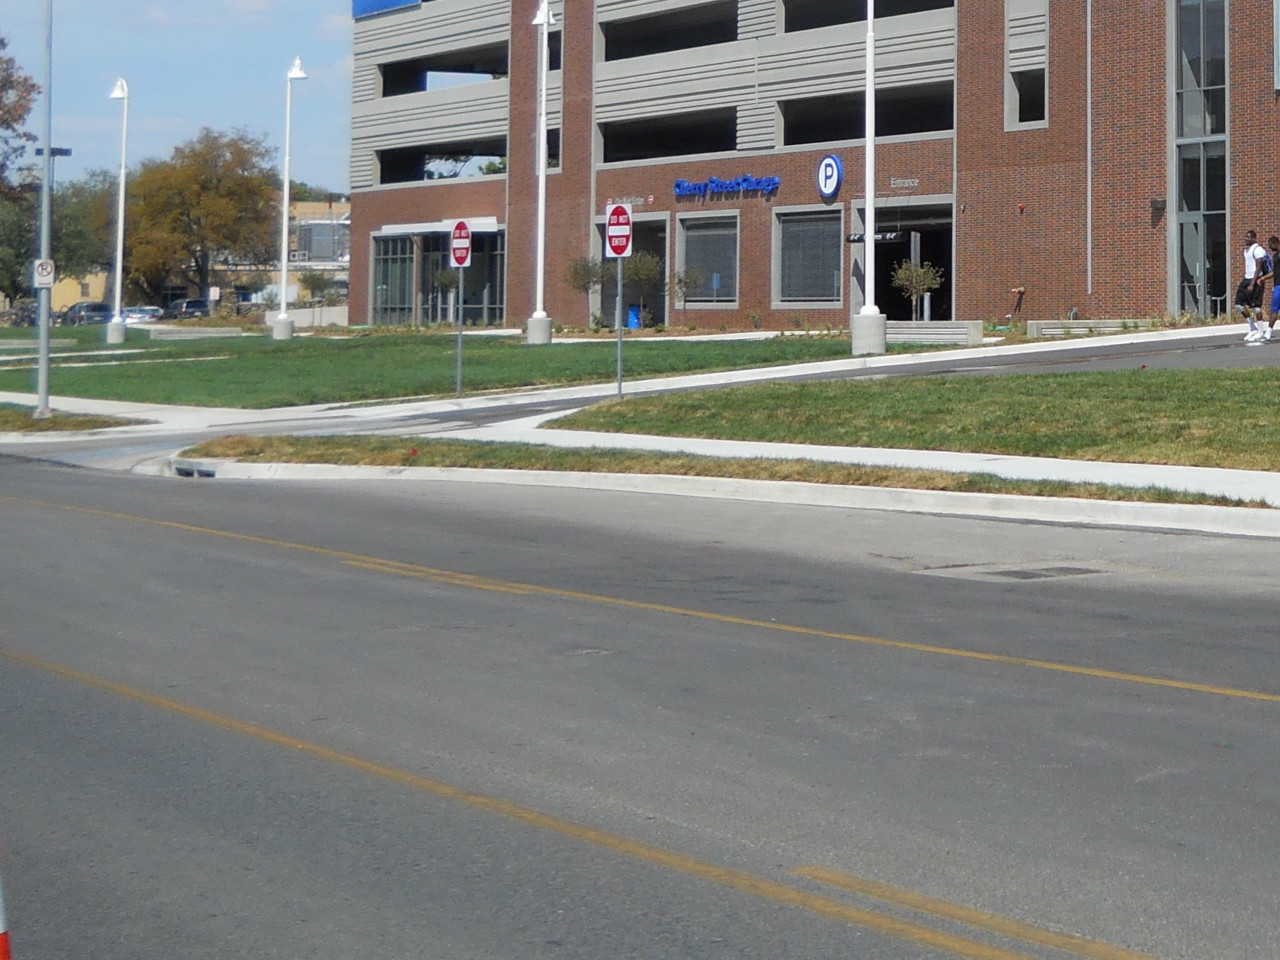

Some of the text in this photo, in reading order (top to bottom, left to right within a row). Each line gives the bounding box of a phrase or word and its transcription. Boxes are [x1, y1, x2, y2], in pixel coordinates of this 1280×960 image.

[824, 162, 834, 188] P
[708, 176, 741, 193] Street
[741, 173, 780, 194] Garage
[890, 177, 919, 188] Entrance
[610, 214, 628, 224] DO NOT
[611, 237, 627, 247] ENTER
